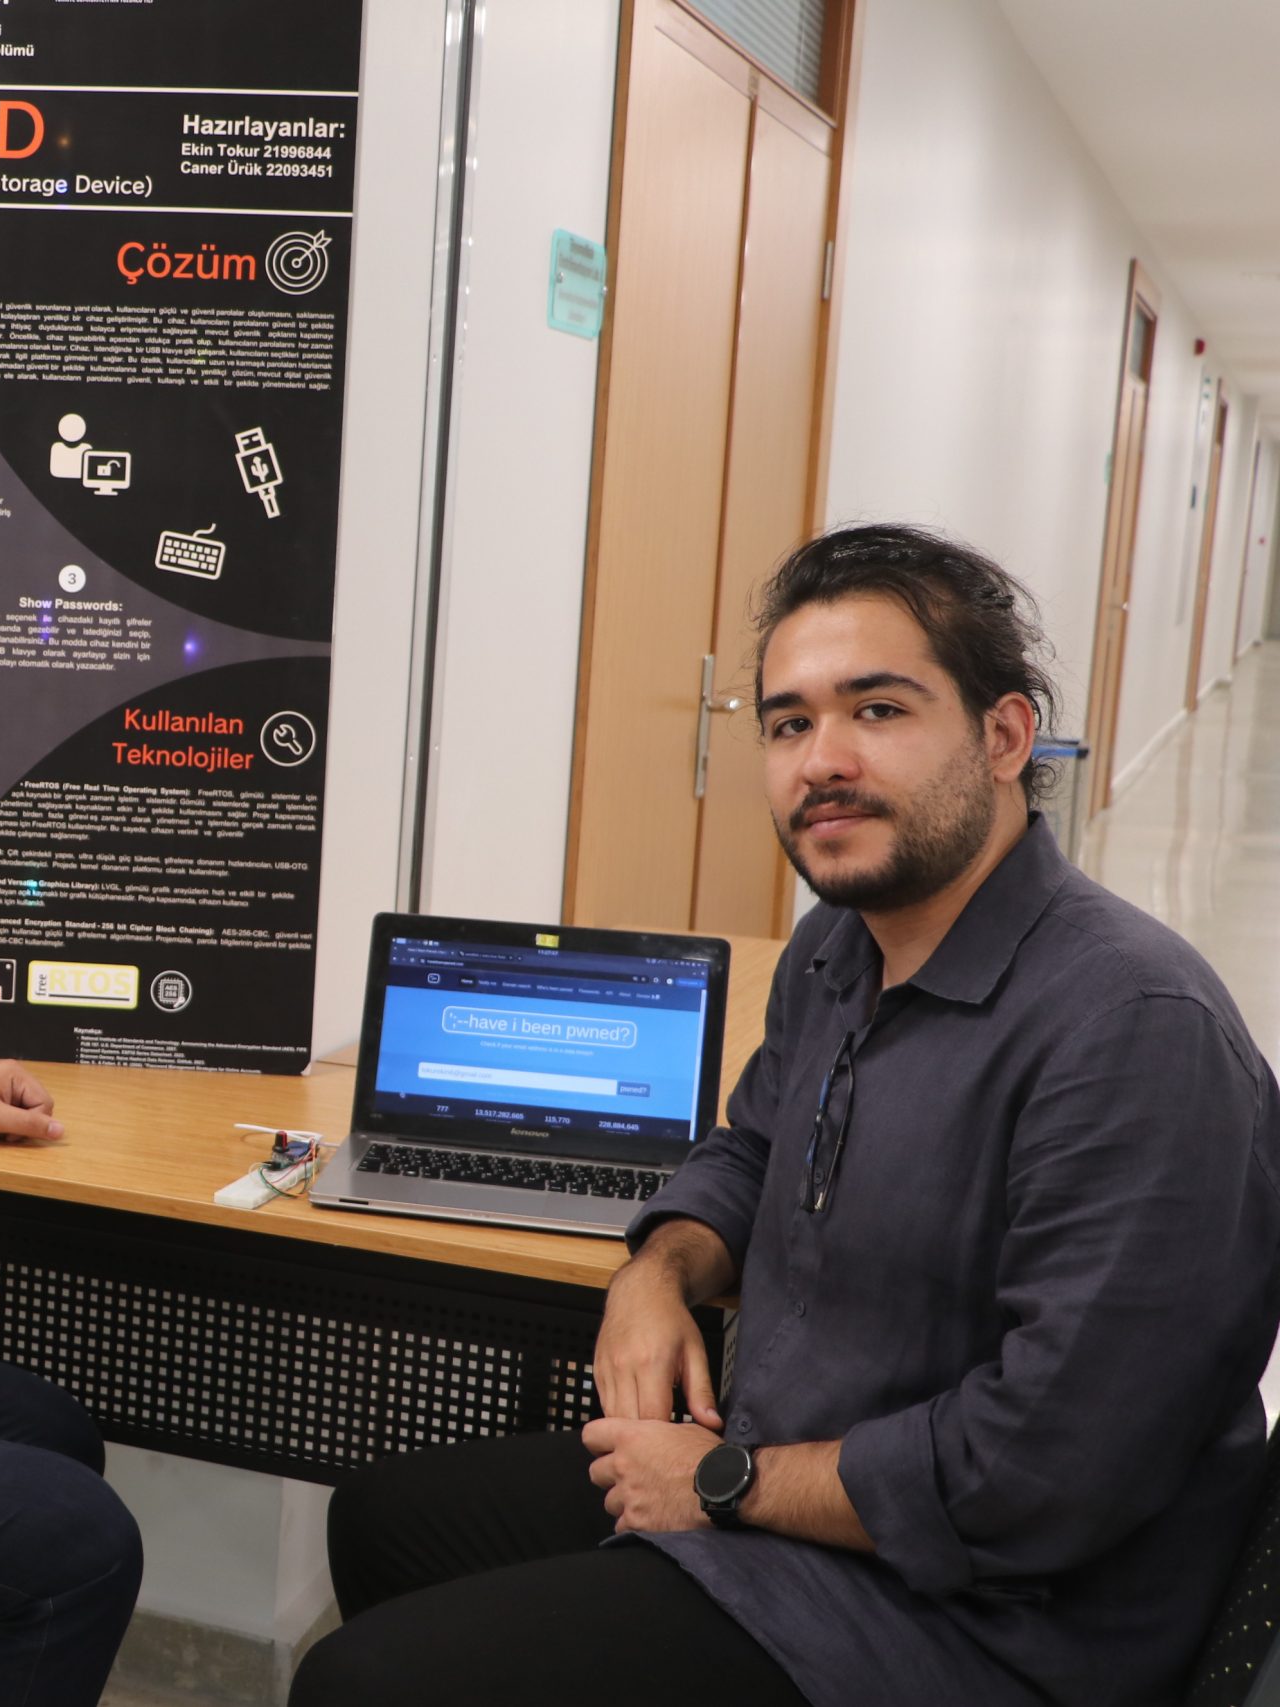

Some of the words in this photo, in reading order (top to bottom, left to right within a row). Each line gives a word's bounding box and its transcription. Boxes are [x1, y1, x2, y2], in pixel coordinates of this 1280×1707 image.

[183, 115, 345, 138] Hazırlayanlar:
[181, 143, 213, 155] Ekin
[217, 144, 260, 156] Tokur
[263, 145, 331, 158] 21996844
[180, 161, 224, 174] Caner
[227, 161, 261, 175] Ürük
[265, 163, 332, 177] 22093451
[75, 175, 152, 196] Device)
[117, 242, 256, 284] Çözüm
[67, 573, 77, 585] 3
[19, 597, 52, 608] Show
[54, 599, 122, 610] Passwords:
[124, 709, 243, 734] Kullanılan
[112, 742, 254, 770] Teknolojiler
[35, 974, 47, 997] free
[49, 968, 131, 995] RTOS
[512, 1017, 517, 1032] i
[521, 1018, 561, 1036] been
[566, 1025, 631, 1042] pwned?
